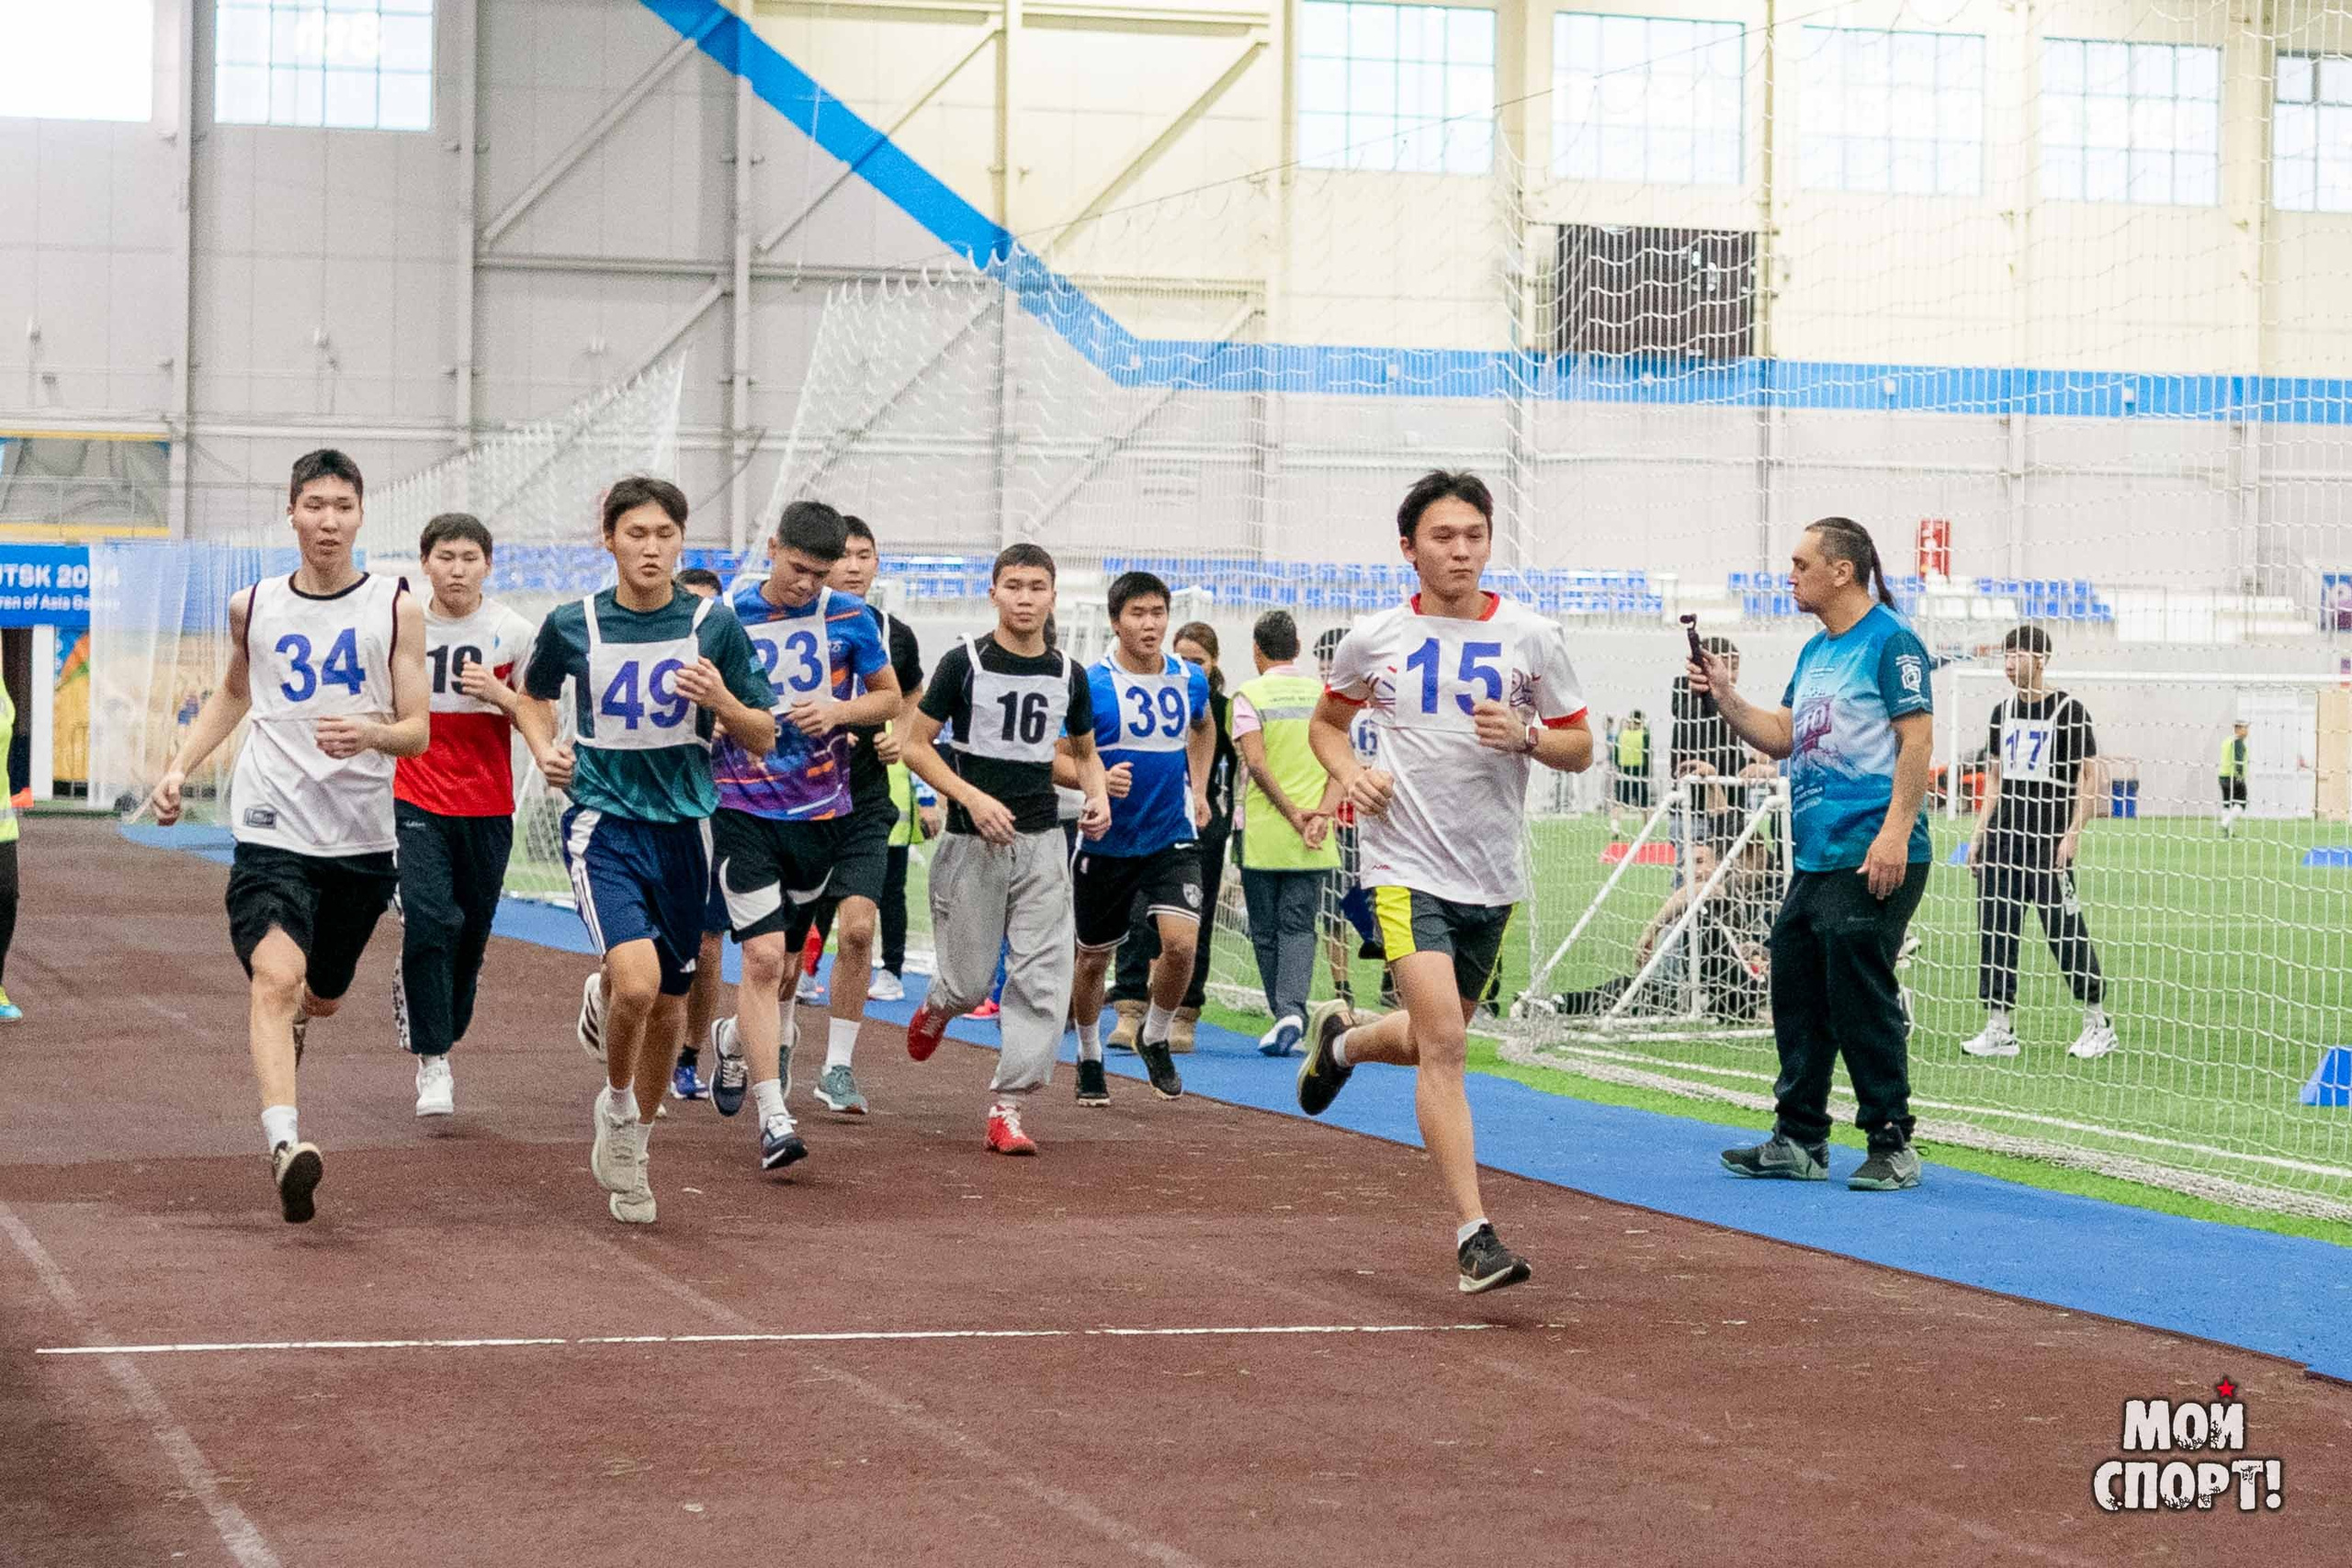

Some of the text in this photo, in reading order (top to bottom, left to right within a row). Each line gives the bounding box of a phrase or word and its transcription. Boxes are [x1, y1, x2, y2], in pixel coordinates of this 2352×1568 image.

[0, 563, 51, 588] TSK
[276, 627, 366, 703] 34
[426, 645, 482, 695] 19
[753, 630, 823, 695] 23
[1407, 637, 1503, 716] 15
[601, 659, 691, 730] 49
[997, 691, 1049, 745] 16
[1125, 686, 1185, 739] 39
[1352, 719, 1378, 756] 6
[2006, 729, 2048, 771] 17
